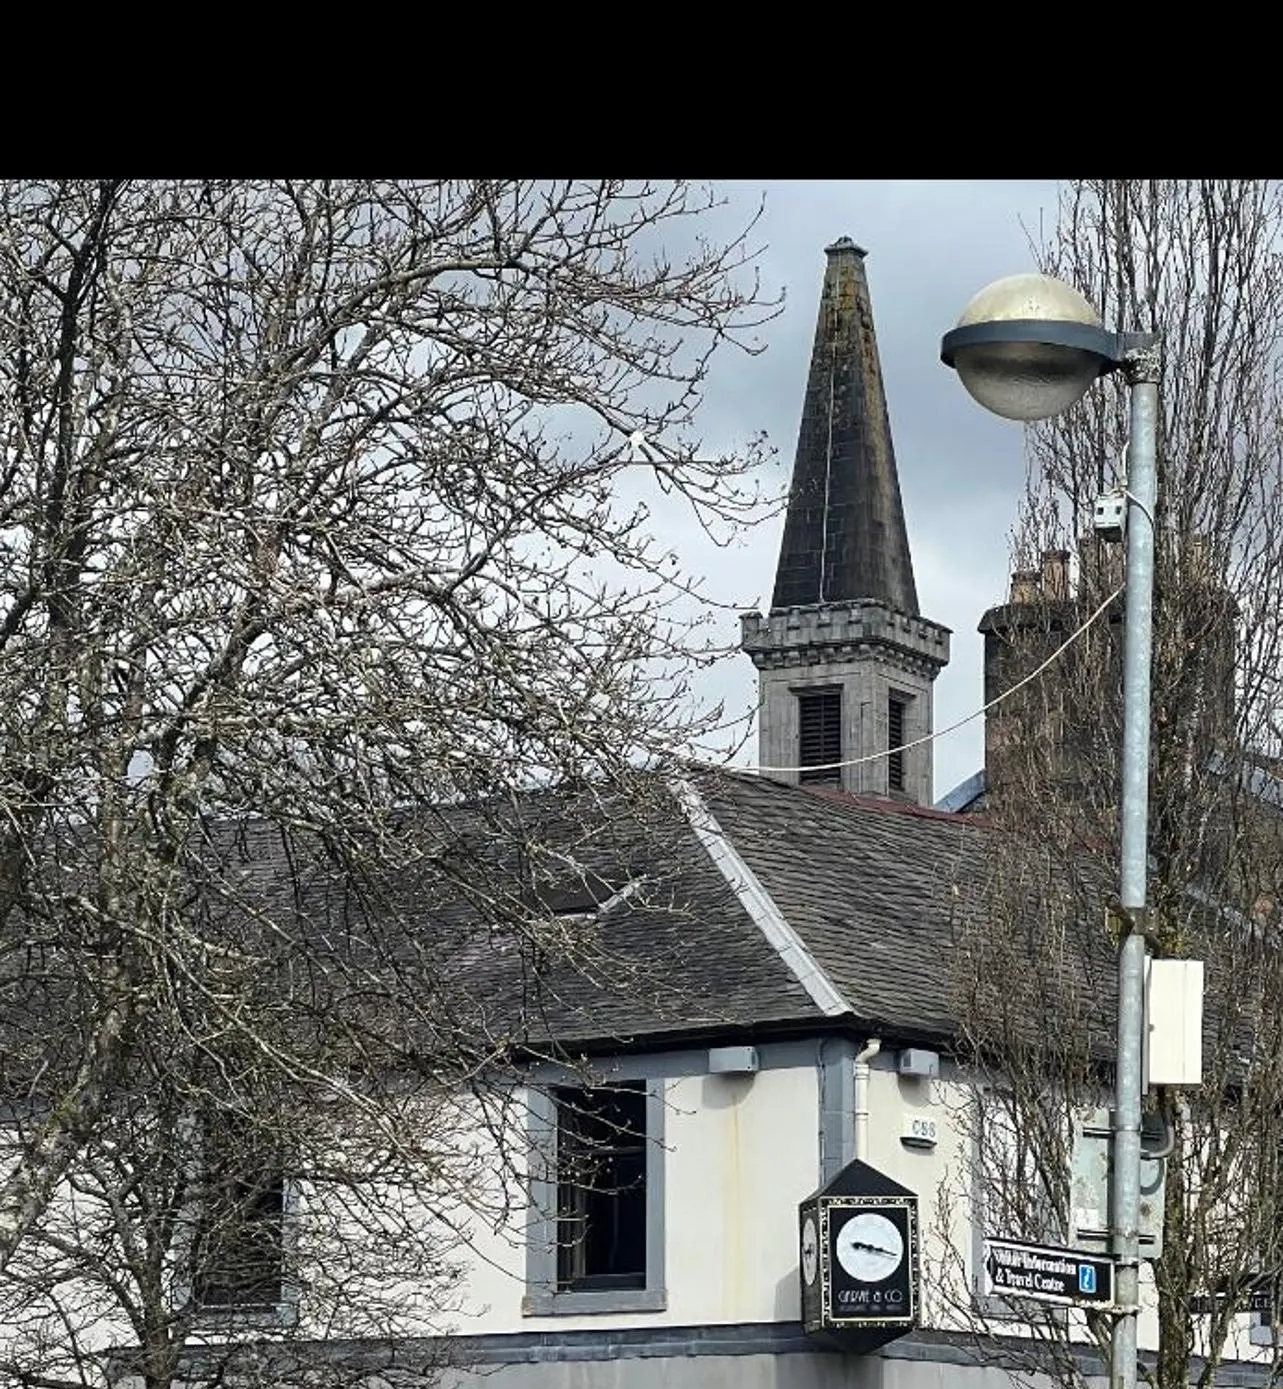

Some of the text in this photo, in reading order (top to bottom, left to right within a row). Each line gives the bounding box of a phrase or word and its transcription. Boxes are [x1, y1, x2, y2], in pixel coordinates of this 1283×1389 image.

[995, 1267, 1066, 1293] & Travel Centre
[884, 1288, 903, 1303] CO
